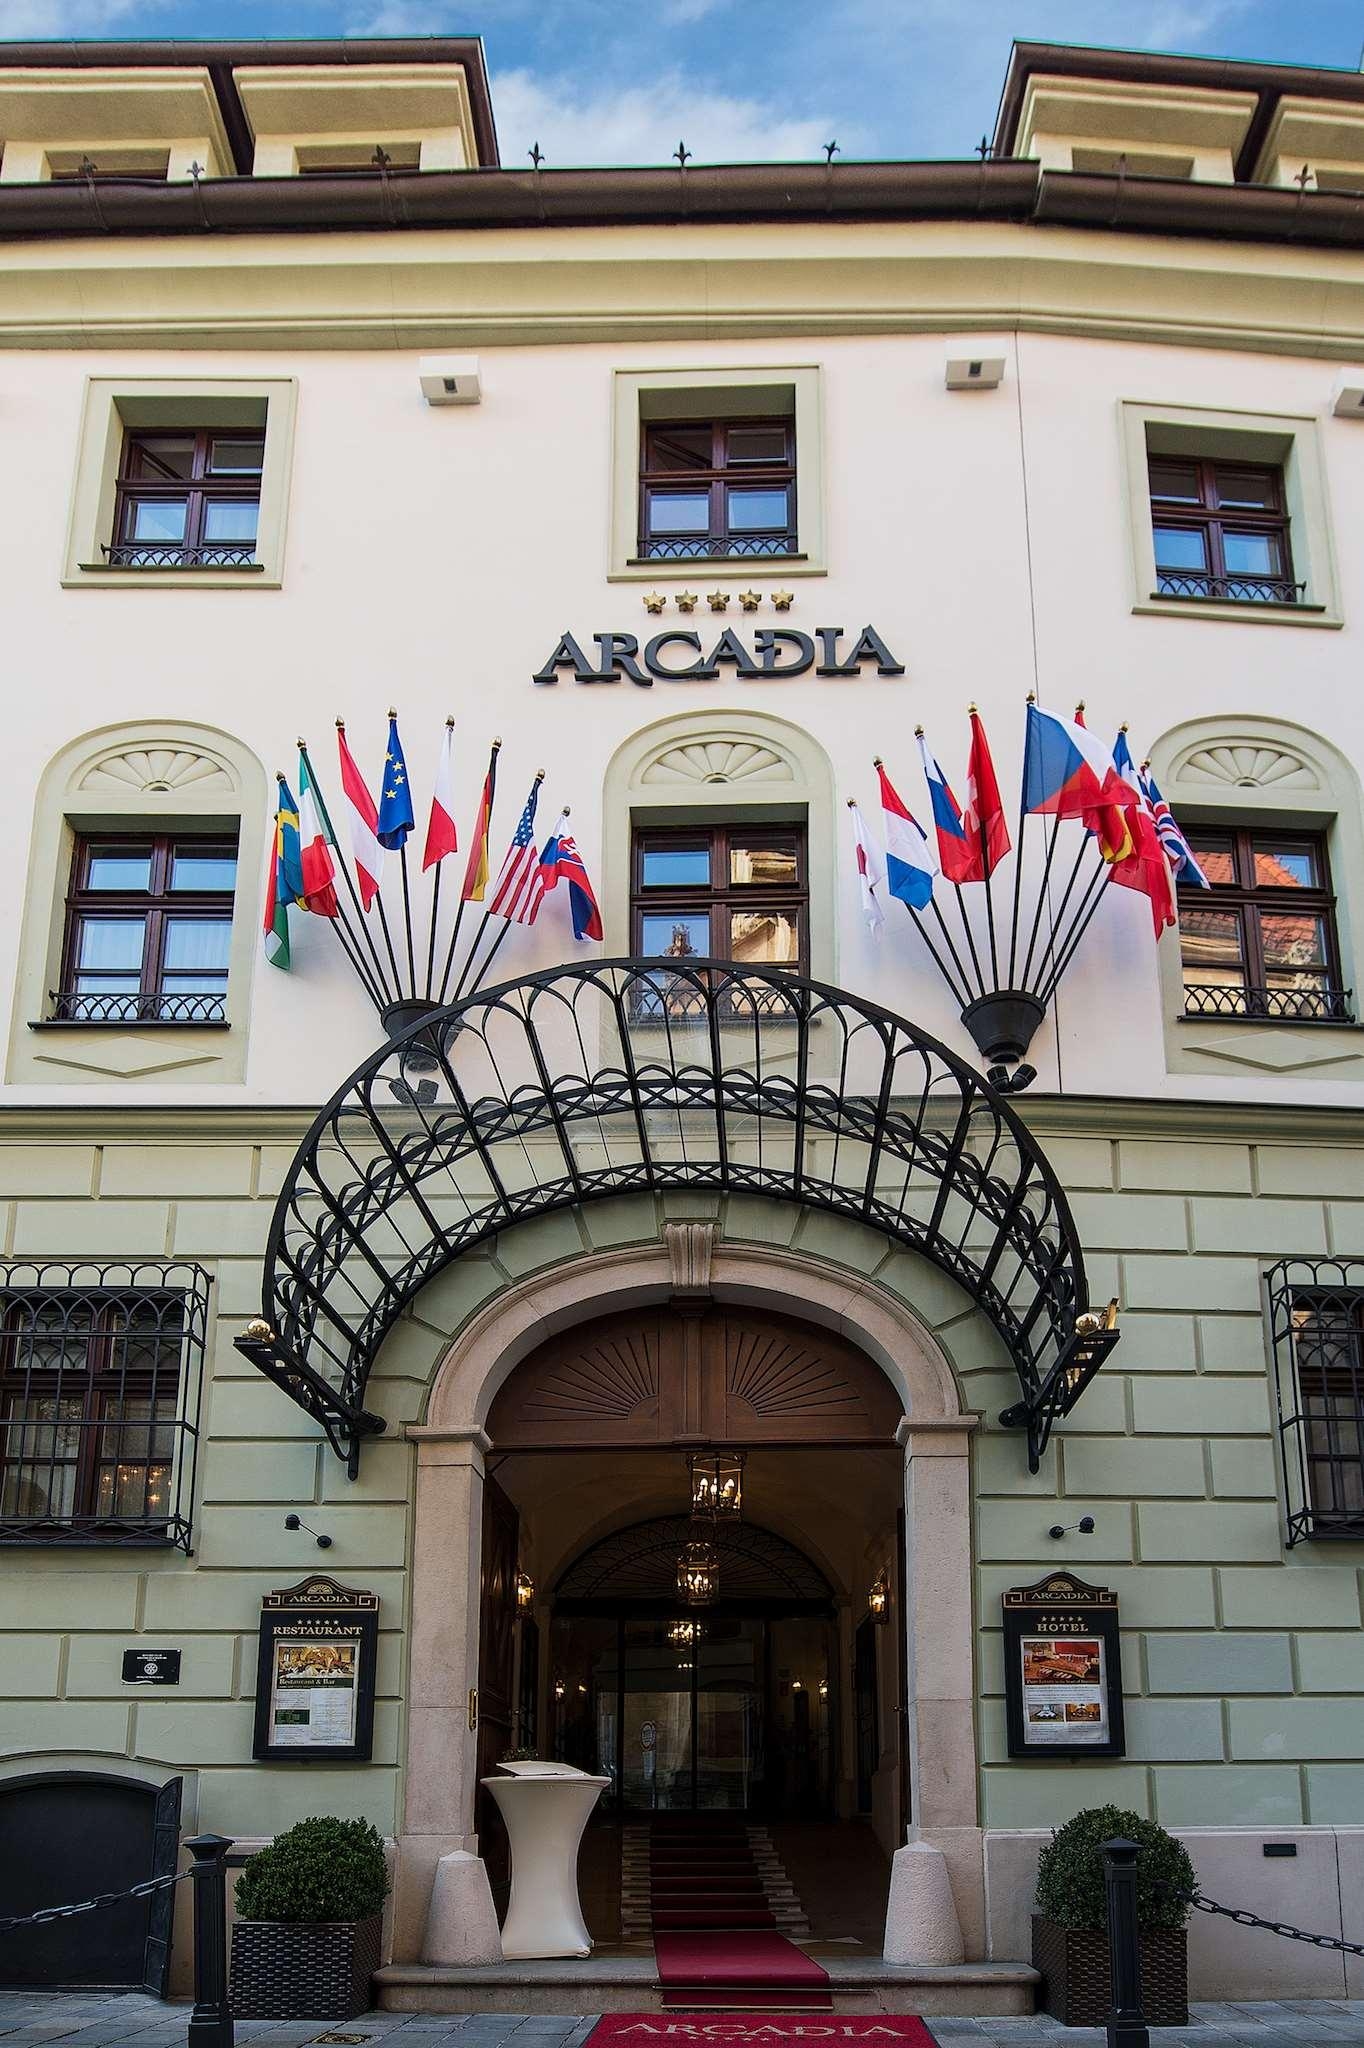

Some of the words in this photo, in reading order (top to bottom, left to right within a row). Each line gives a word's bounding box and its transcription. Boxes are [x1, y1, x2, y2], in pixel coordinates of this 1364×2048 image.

[532, 623, 906, 687] ARCADIA
[289, 1594, 350, 1604] ARCADIA
[1031, 1591, 1091, 1600] ARCADIA
[272, 1626, 363, 1636] RESTAURANT
[1036, 1623, 1089, 1632] HOTEL
[612, 2022, 908, 2037] ARCADIA
